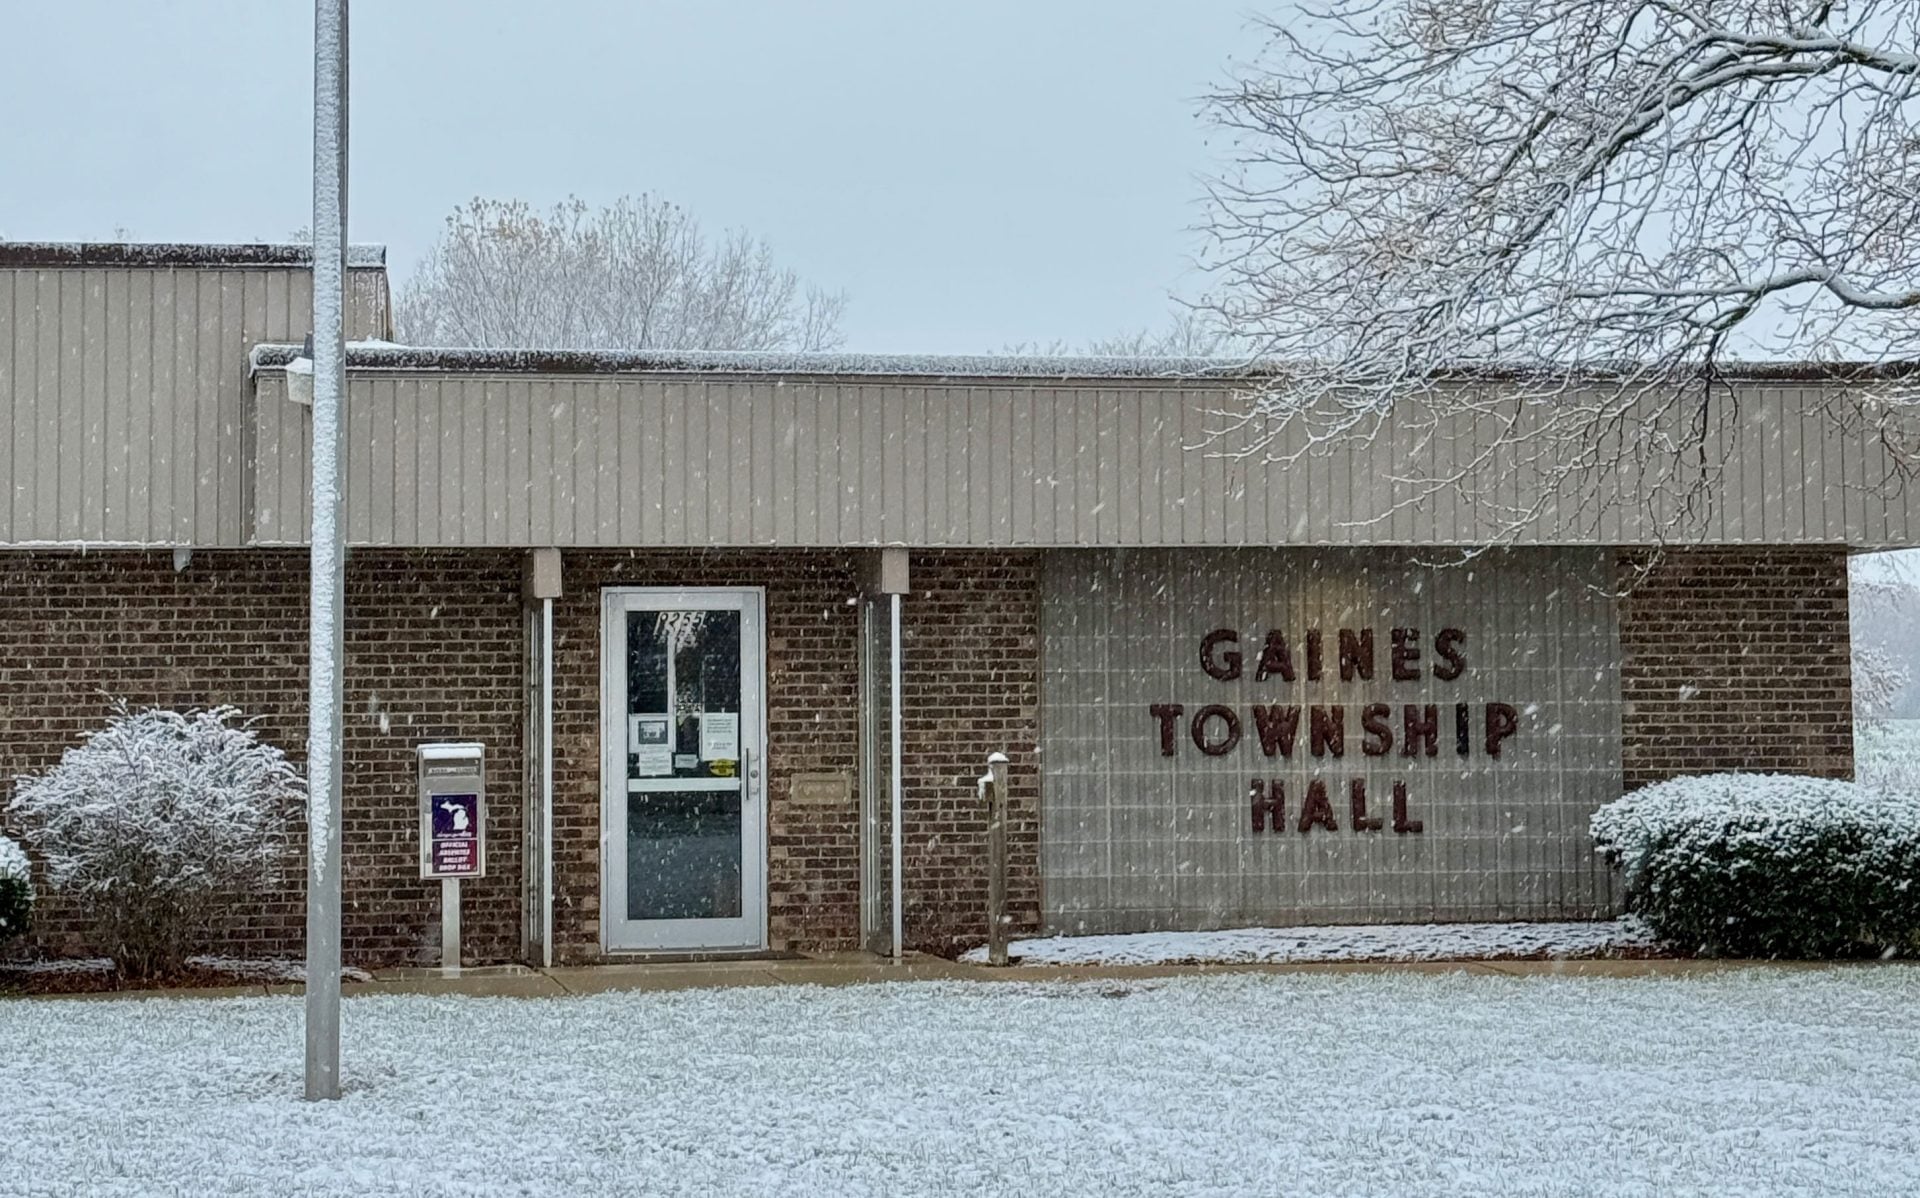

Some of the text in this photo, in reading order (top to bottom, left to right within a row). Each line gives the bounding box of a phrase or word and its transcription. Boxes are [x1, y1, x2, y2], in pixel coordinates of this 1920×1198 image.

[1199, 628, 1467, 682] GAINES
[1149, 702, 1518, 758] TOWNSHIP
[1250, 777, 1423, 833] HALL
